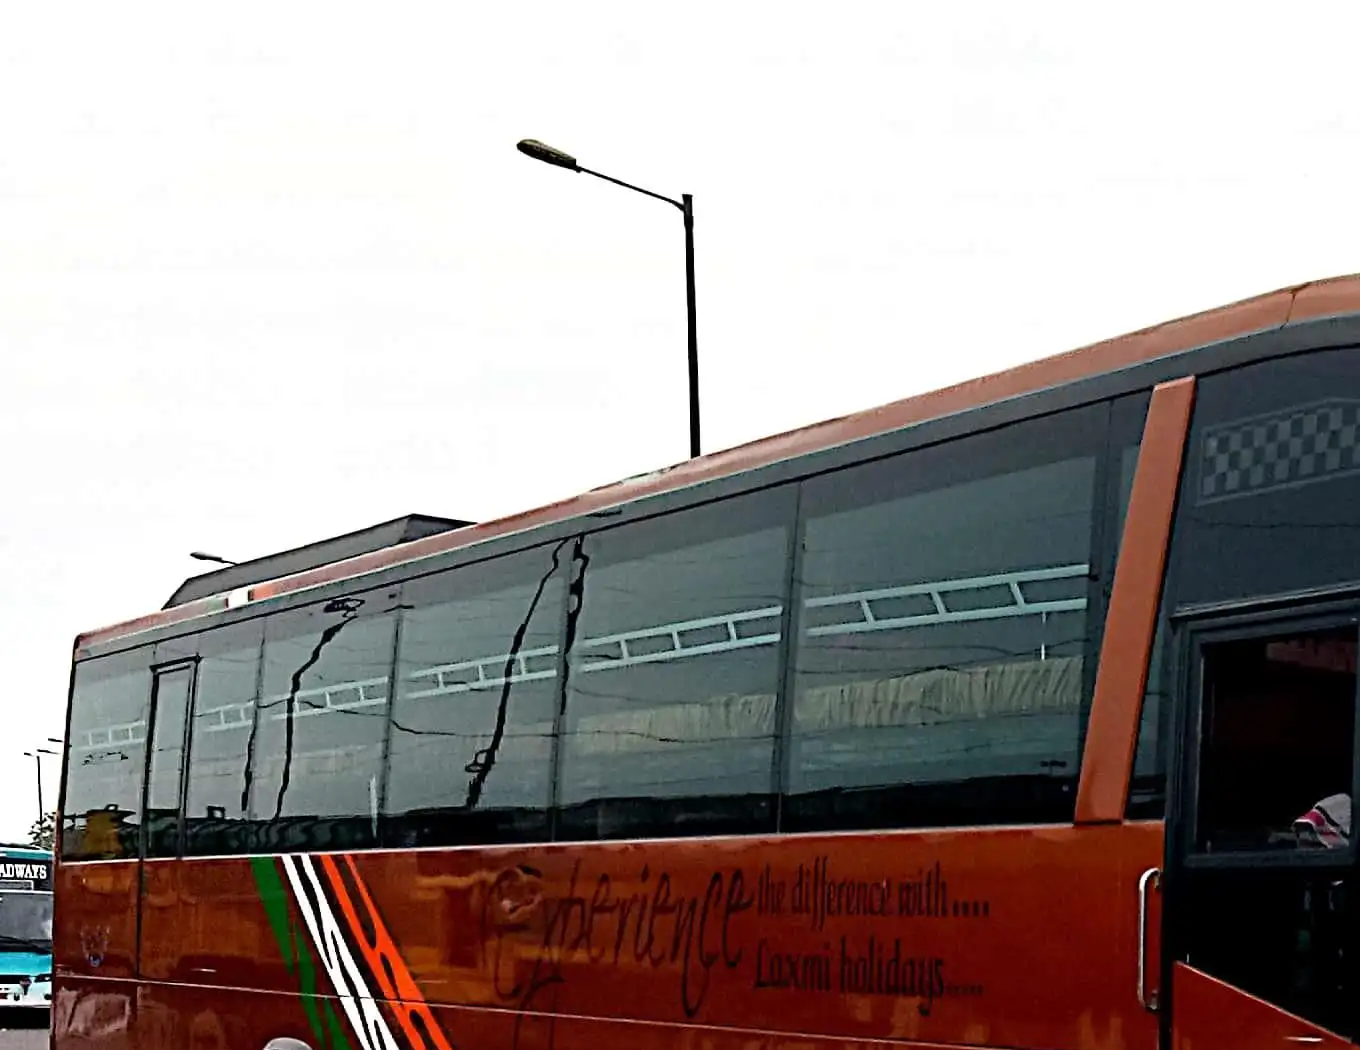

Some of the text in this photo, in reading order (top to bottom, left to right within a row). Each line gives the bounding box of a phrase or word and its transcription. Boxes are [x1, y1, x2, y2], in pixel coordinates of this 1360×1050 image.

[757, 863, 786, 915] the
[792, 856, 891, 931] difference
[754, 938, 832, 992] Laxmi
